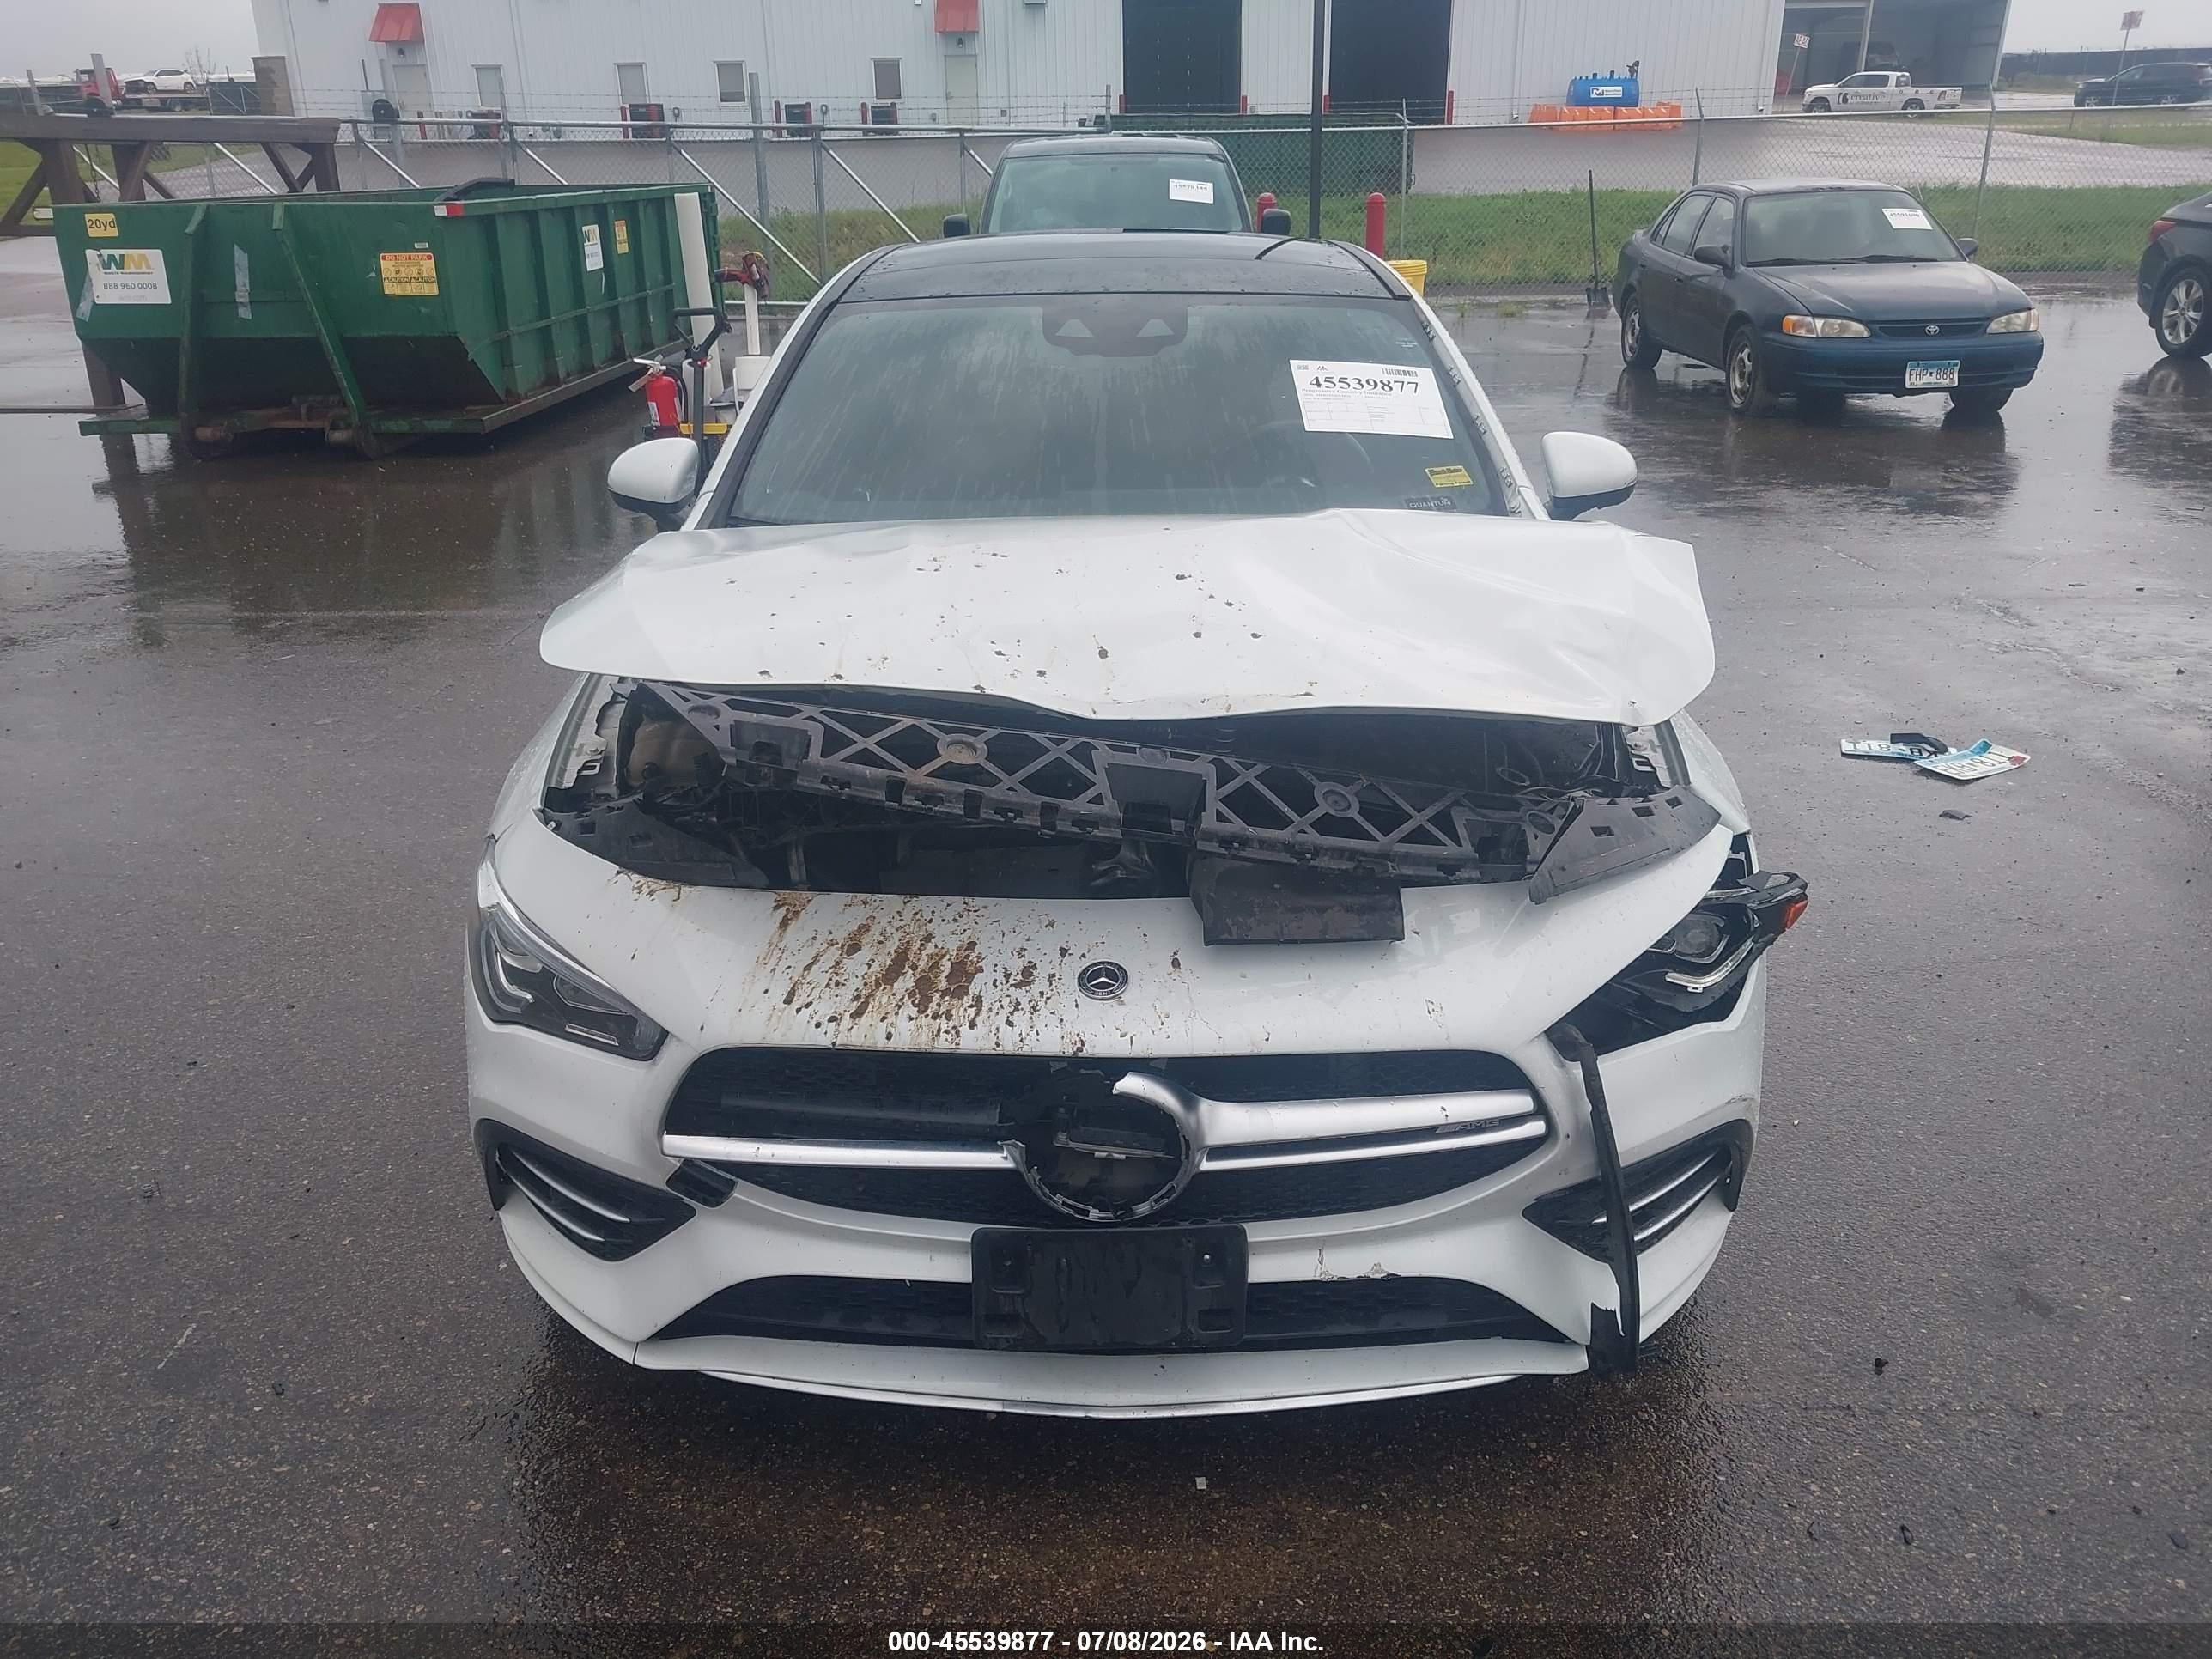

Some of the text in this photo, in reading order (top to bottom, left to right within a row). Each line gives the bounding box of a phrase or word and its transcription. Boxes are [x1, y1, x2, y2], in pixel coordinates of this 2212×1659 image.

[88, 218, 116, 231] 20yd
[97, 253, 152, 270] WM
[1909, 368, 1955, 381] FHP 888
[1309, 376, 1419, 394] 45539877
[1455, 1119, 1500, 1131] AMG
